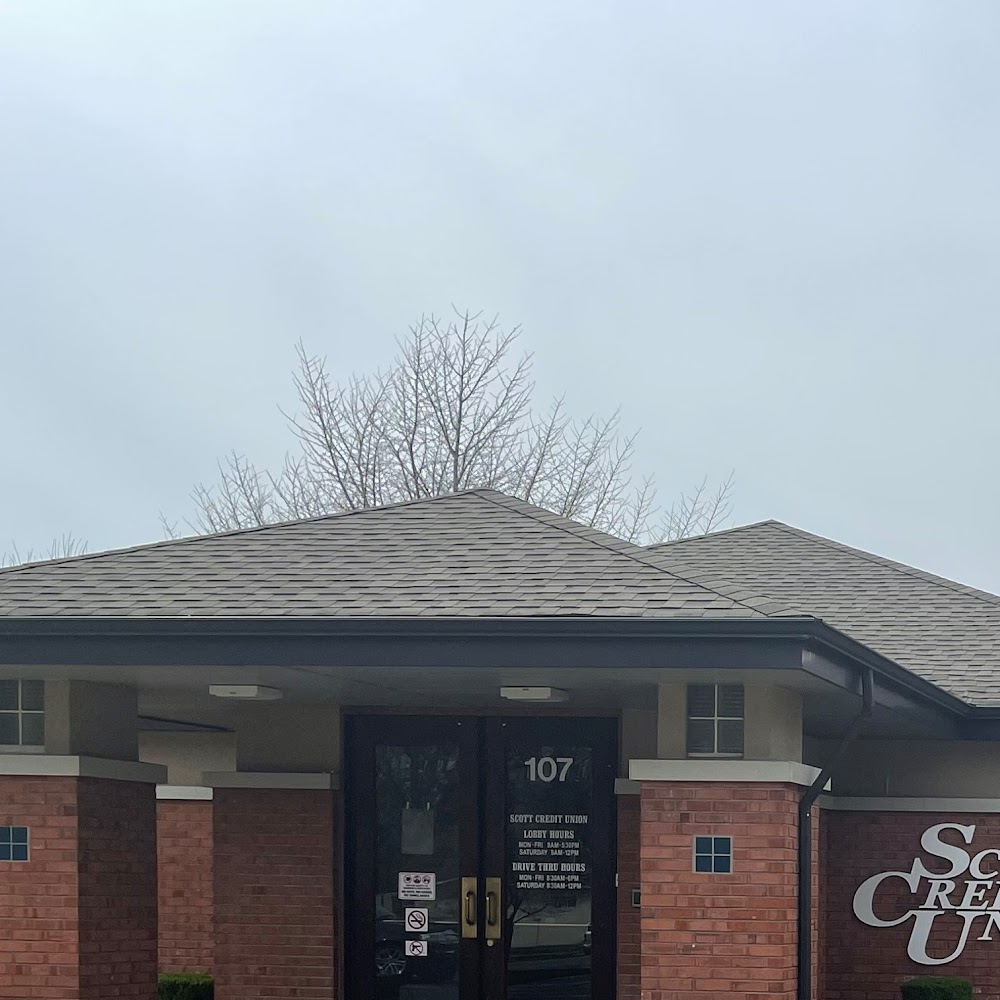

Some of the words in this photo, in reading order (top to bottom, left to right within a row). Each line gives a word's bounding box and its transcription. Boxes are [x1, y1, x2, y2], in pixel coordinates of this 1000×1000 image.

[524, 757, 574, 782] 107
[510, 814, 534, 823] SCOTT
[535, 814, 563, 824] CREDIT
[564, 814, 588, 824] UNION
[523, 829, 547, 838] LOBBY
[549, 829, 575, 838] HOURS
[519, 848, 548, 856] SATURDAY
[512, 862, 536, 871] DRIVE
[537, 862, 559, 871] THRU
[560, 862, 586, 872] HOURS
